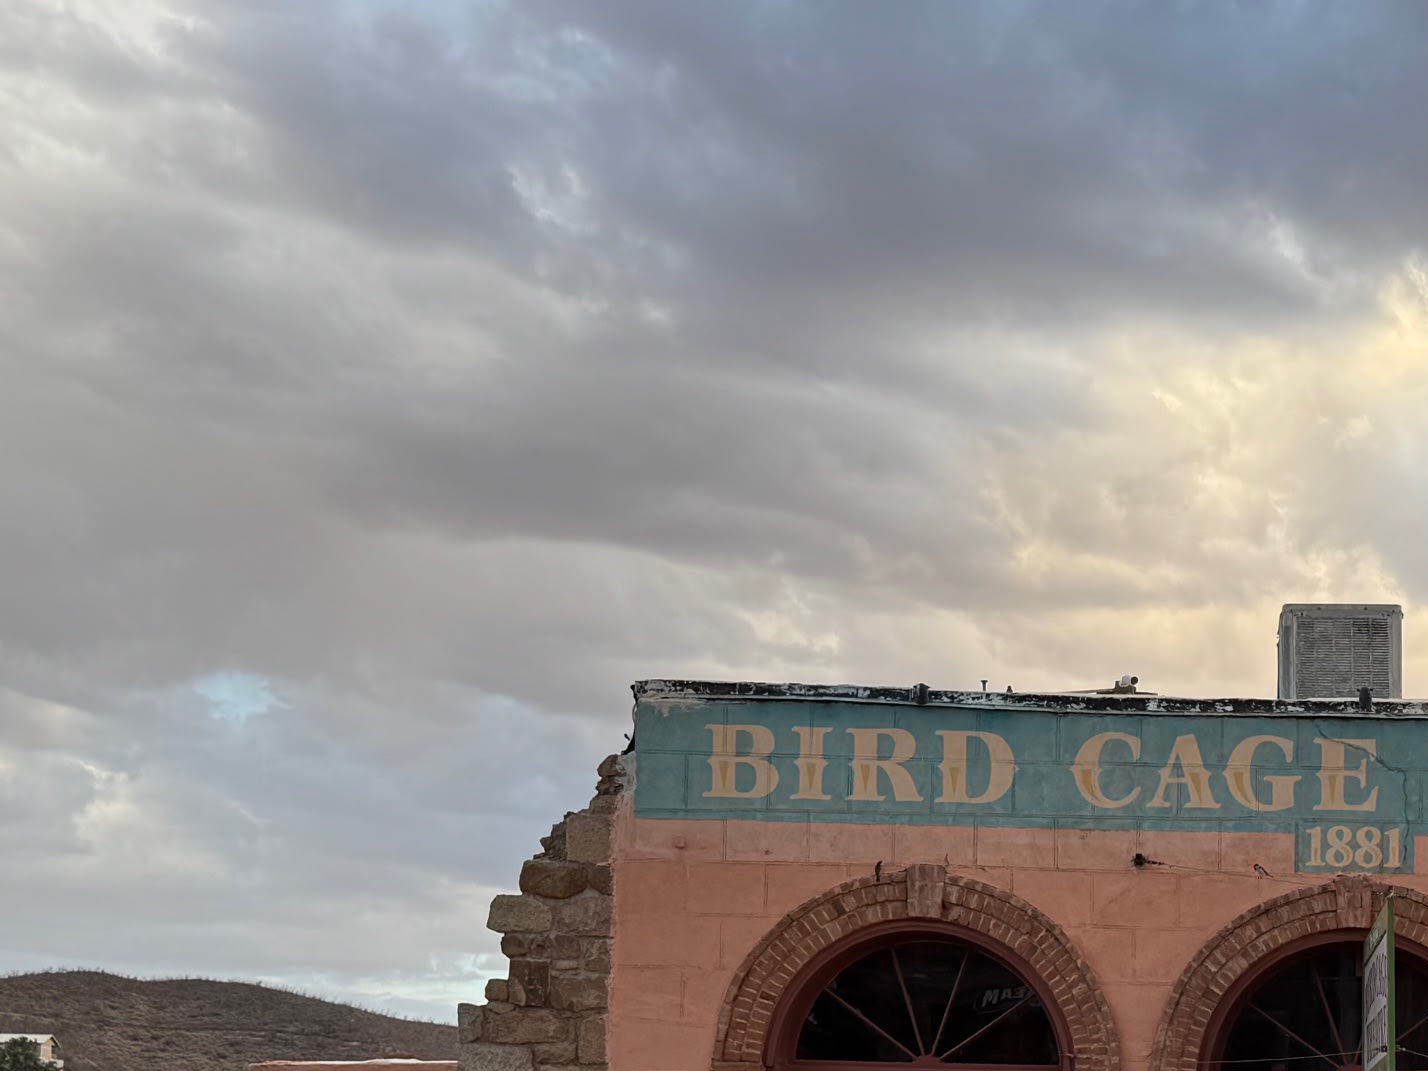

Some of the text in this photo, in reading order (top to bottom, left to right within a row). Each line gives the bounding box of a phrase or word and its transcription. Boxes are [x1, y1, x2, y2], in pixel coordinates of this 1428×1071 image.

[702, 724, 1018, 804] BIRD
[1069, 731, 1378, 811] CAGE
[1306, 826, 1400, 868] 1881
